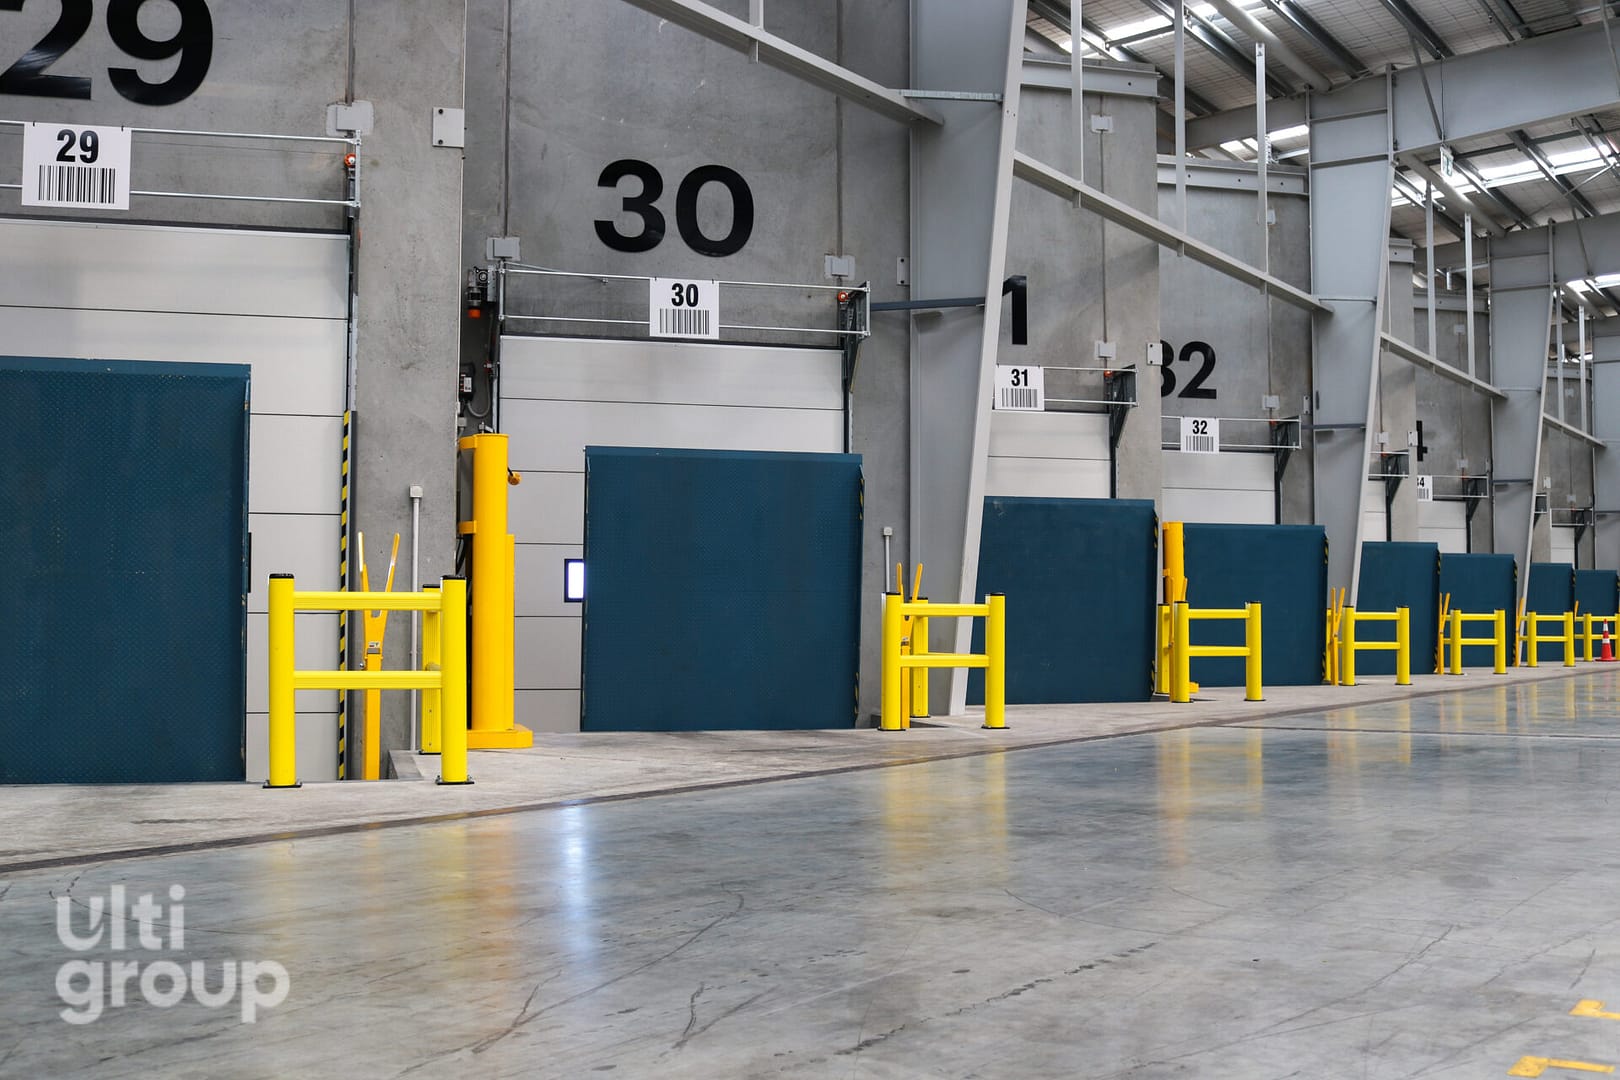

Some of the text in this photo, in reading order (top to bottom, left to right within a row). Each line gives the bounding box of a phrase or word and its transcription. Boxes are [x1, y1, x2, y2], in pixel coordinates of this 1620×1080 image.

[0, 0, 214, 107] 29
[55, 129, 99, 164] 29
[593, 158, 755, 258] 30
[671, 282, 699, 308] 30
[1001, 275, 1028, 346] 1
[1011, 368, 1028, 387] 31
[1192, 419, 1208, 435] 32
